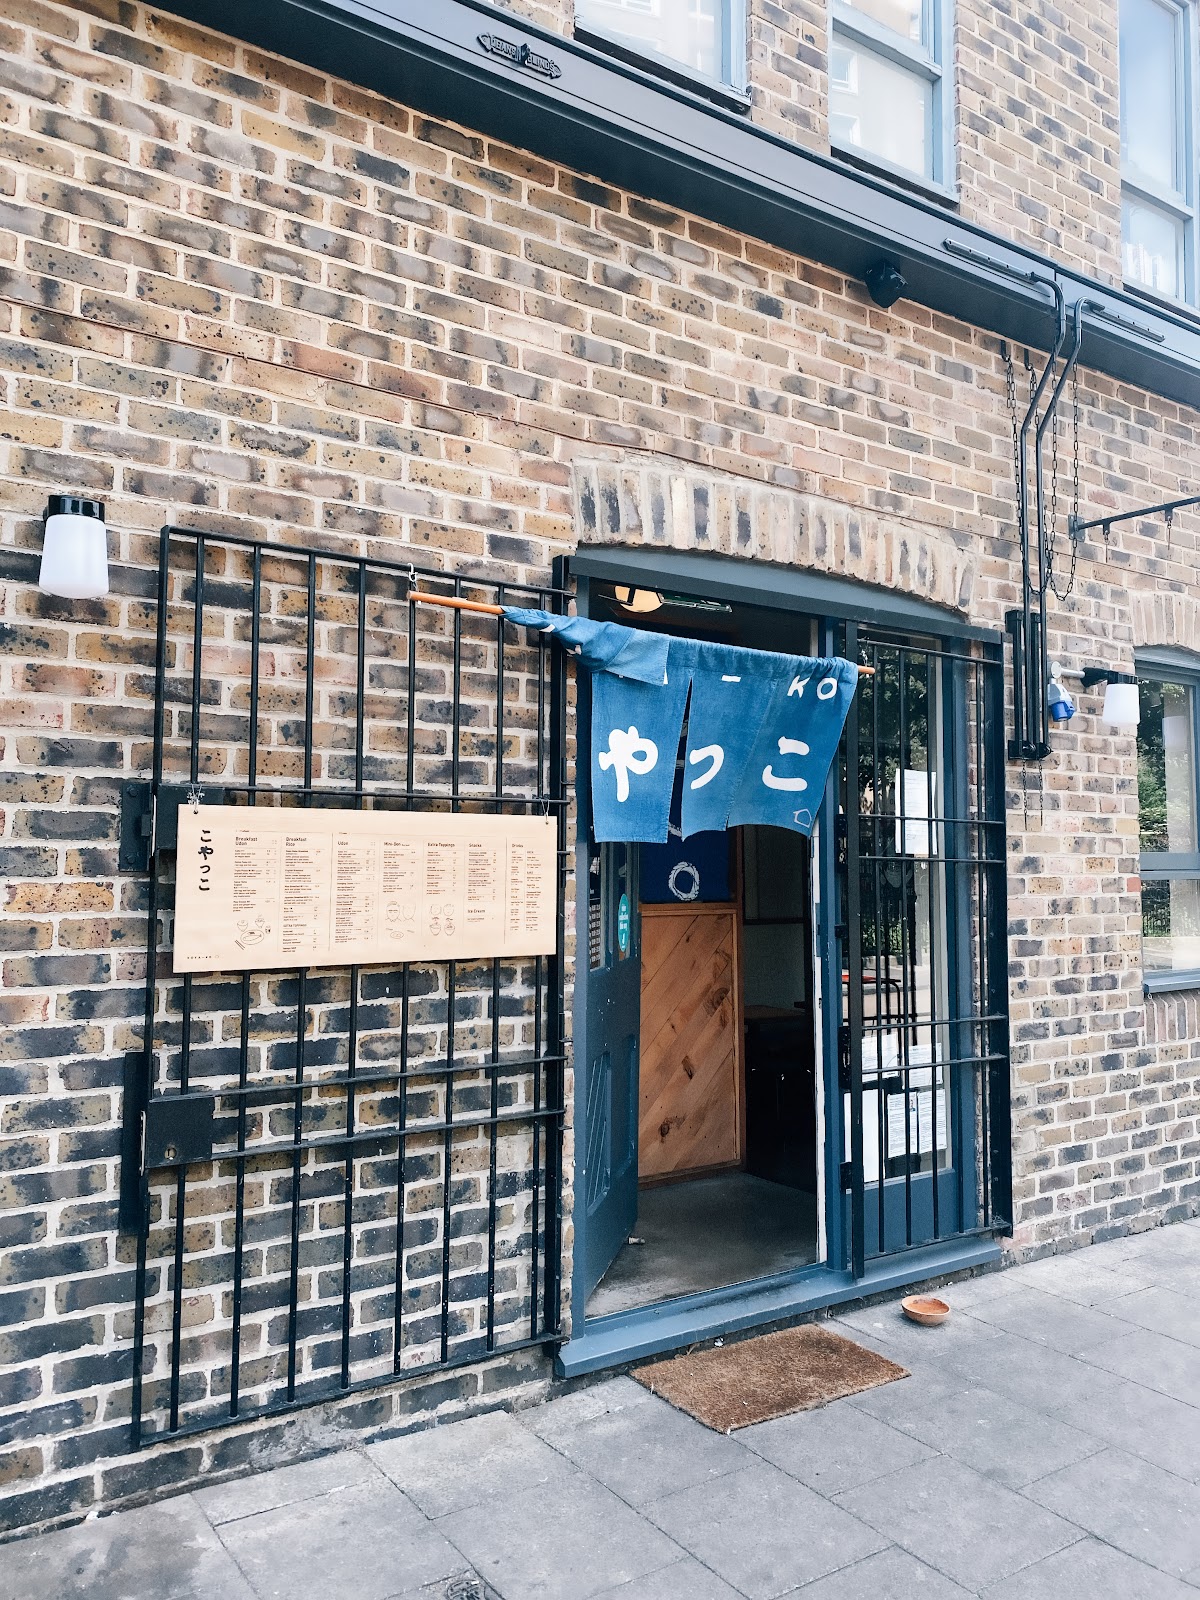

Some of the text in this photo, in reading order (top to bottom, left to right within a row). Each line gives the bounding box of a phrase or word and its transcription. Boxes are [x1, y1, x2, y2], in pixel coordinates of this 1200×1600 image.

[490, 36, 554, 71] DEANS BLINDS
[197, 829, 214, 891] こやっこ
